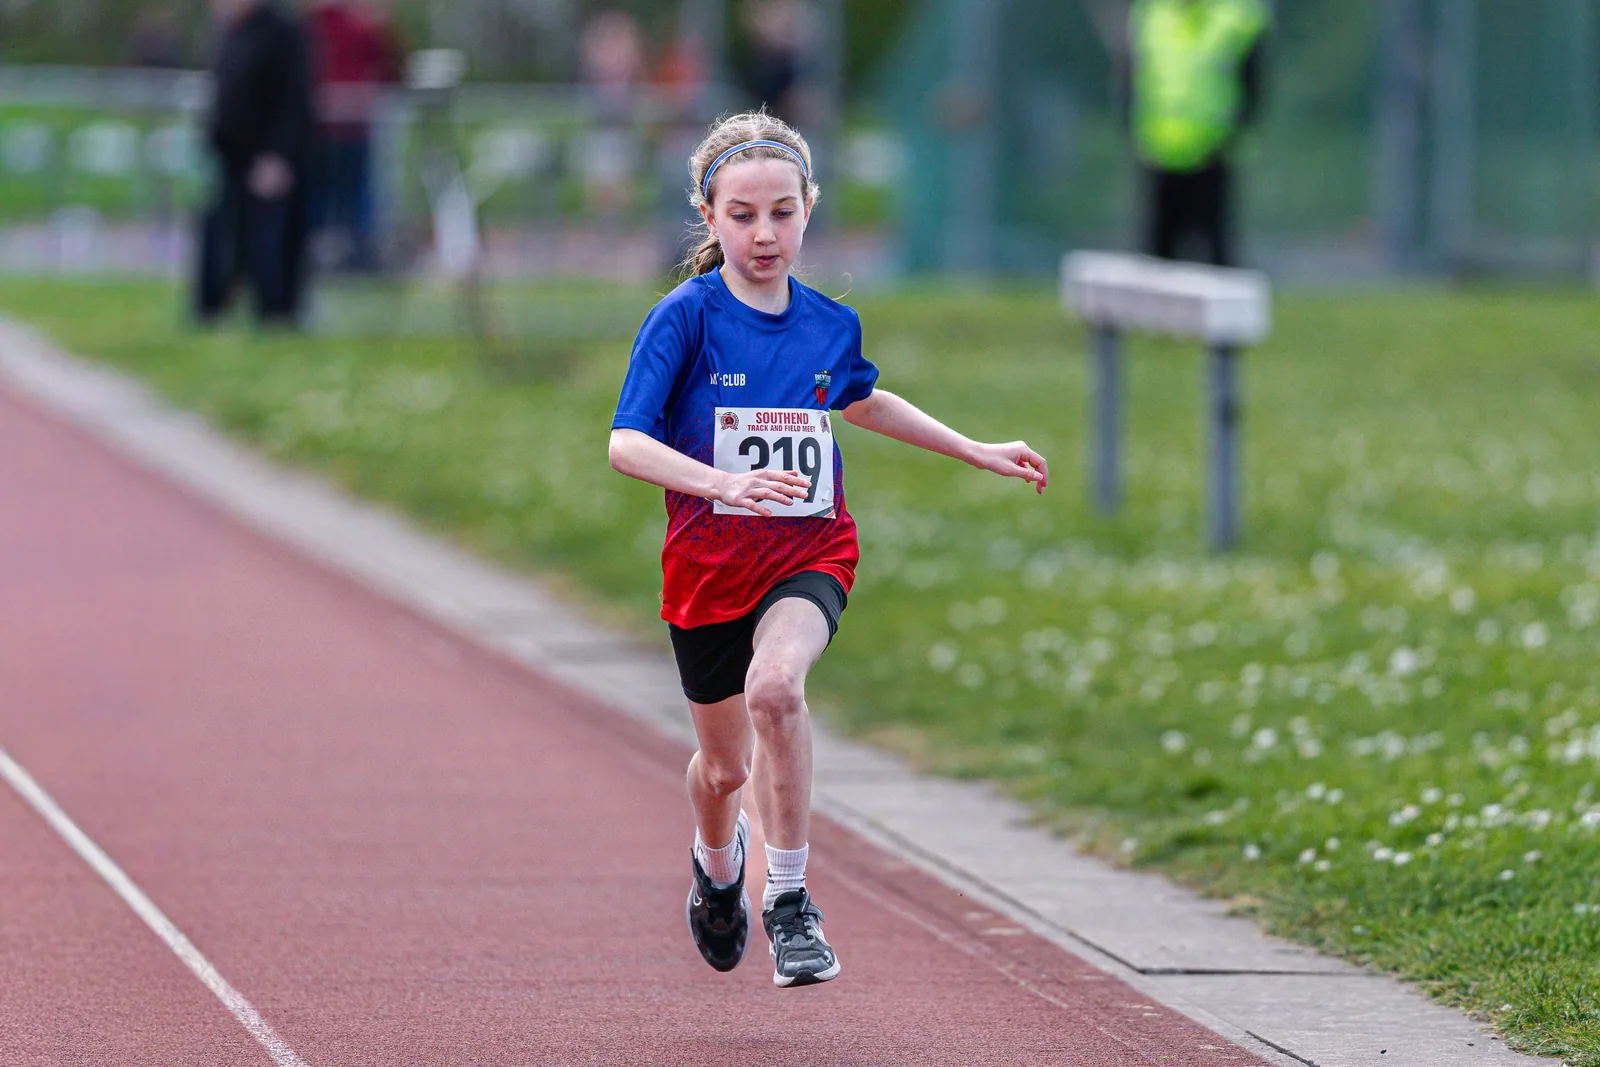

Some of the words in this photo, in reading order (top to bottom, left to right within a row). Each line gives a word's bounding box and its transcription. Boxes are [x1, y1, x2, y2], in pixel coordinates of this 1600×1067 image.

[755, 411, 809, 425] SOUTHEND
[747, 424, 769, 432] TRACK
[770, 424, 783, 432] AND
[784, 425, 801, 433] FIELD
[802, 425, 816, 433] MEET
